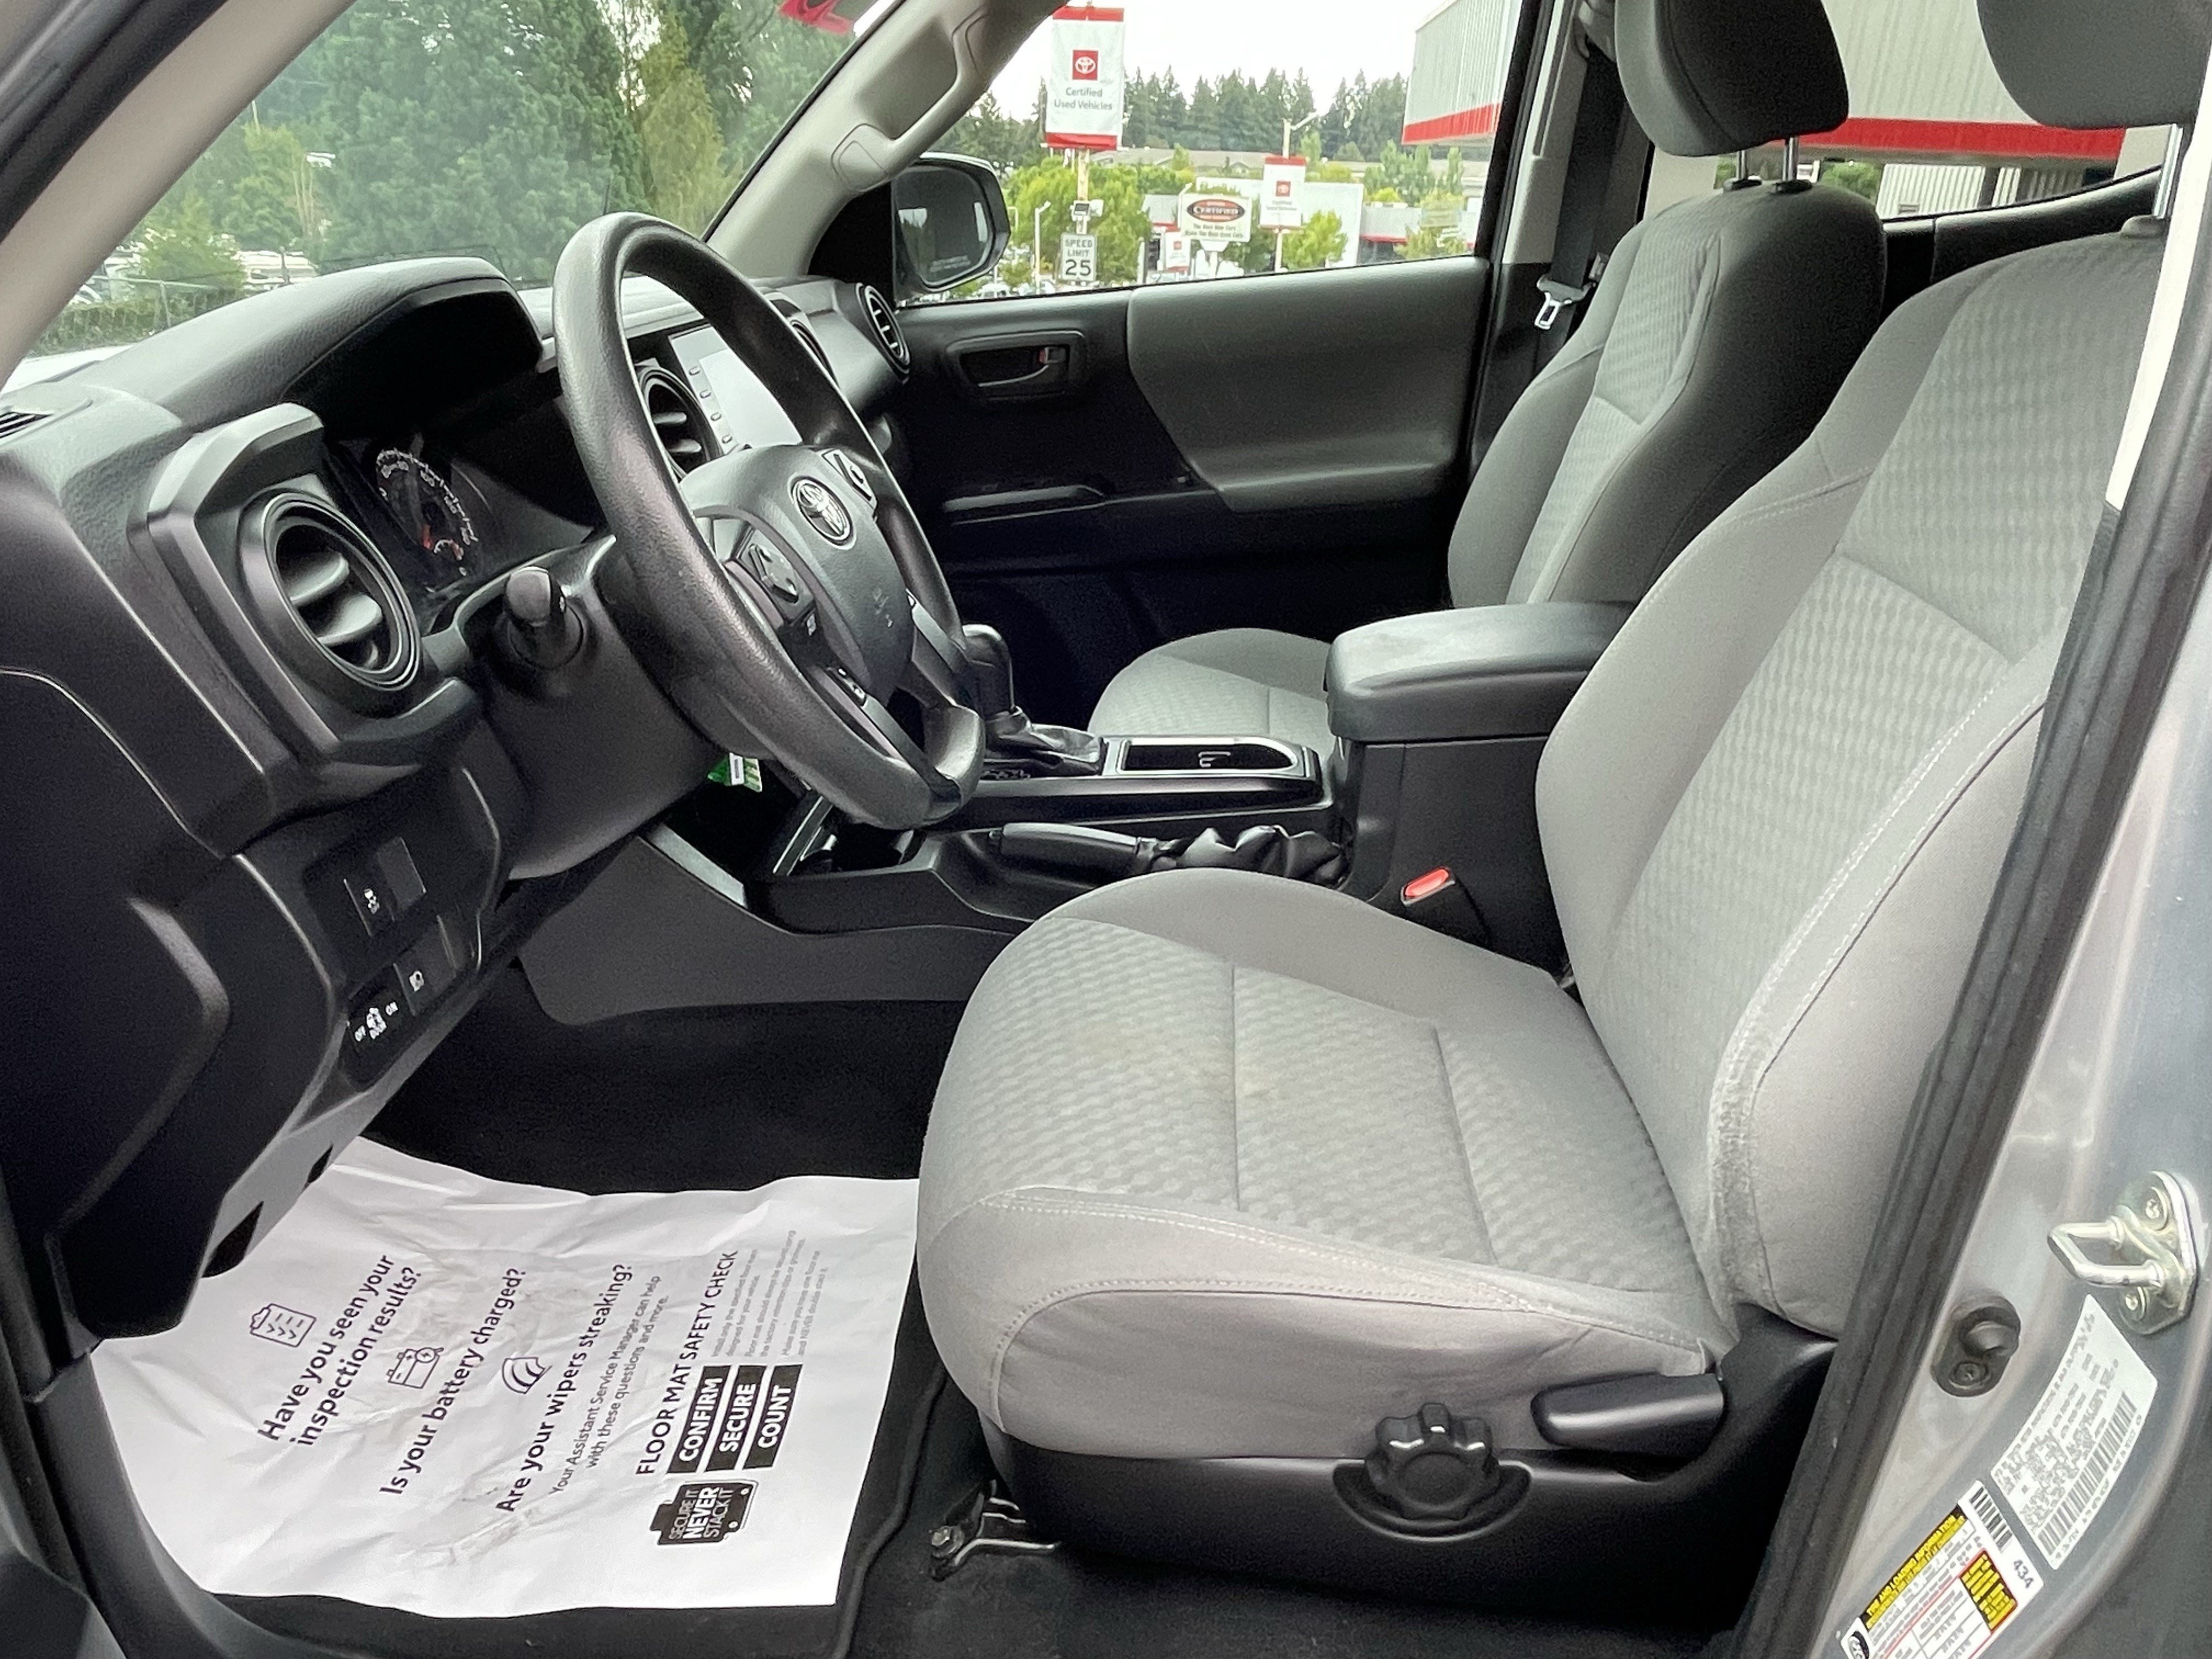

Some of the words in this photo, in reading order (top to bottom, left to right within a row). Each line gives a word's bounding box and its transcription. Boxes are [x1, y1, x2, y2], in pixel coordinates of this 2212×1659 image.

[1054, 99, 1076, 109] Used
[1078, 100, 1113, 110] Vehicles
[1065, 87, 1103, 98] Certified
[1065, 239, 1093, 247] SPEED
[1065, 259, 1091, 276] 25
[635, 1299, 650, 1317] can
[640, 1276, 661, 1297] help
[257, 1384, 309, 1441] Have
[300, 1342, 337, 1384] you
[329, 1296, 368, 1339] seen
[358, 1255, 394, 1296] your
[289, 1337, 377, 1446] inspection
[368, 1267, 421, 1334] results?
[608, 1319, 640, 1360] Manager
[636, 1408, 679, 1475] FLOOR
[662, 1364, 691, 1402] MAT
[680, 1302, 715, 1359] SAFETY
[704, 1250, 738, 1297] CHECK
[380, 1476, 408, 1494] Is
[398, 1424, 437, 1474] your
[422, 1348, 484, 1420] battery
[471, 1267, 526, 1345] charged?
[496, 1477, 531, 1512] Are
[521, 1421, 554, 1471] your
[545, 1352, 587, 1417] wipers
[579, 1264, 633, 1347] streaking?
[585, 1441, 607, 1468] with
[597, 1403, 621, 1437] these
[615, 1346, 645, 1400] questions
[639, 1324, 654, 1343] and
[649, 1296, 669, 1322] more.
[590, 1363, 618, 1404] Service
[566, 1407, 600, 1465] Assistant
[679, 1378, 723, 1462] CONFIRM
[719, 1383, 756, 1452] SECURE
[758, 1385, 791, 1448] COUNT
[549, 1468, 574, 1494] Your
[669, 1498, 696, 1539] SECURE
[686, 1489, 701, 1498] IT
[682, 1487, 720, 1539] NEVER
[703, 1497, 731, 1538] STACK
[719, 1487, 733, 1497] IT
